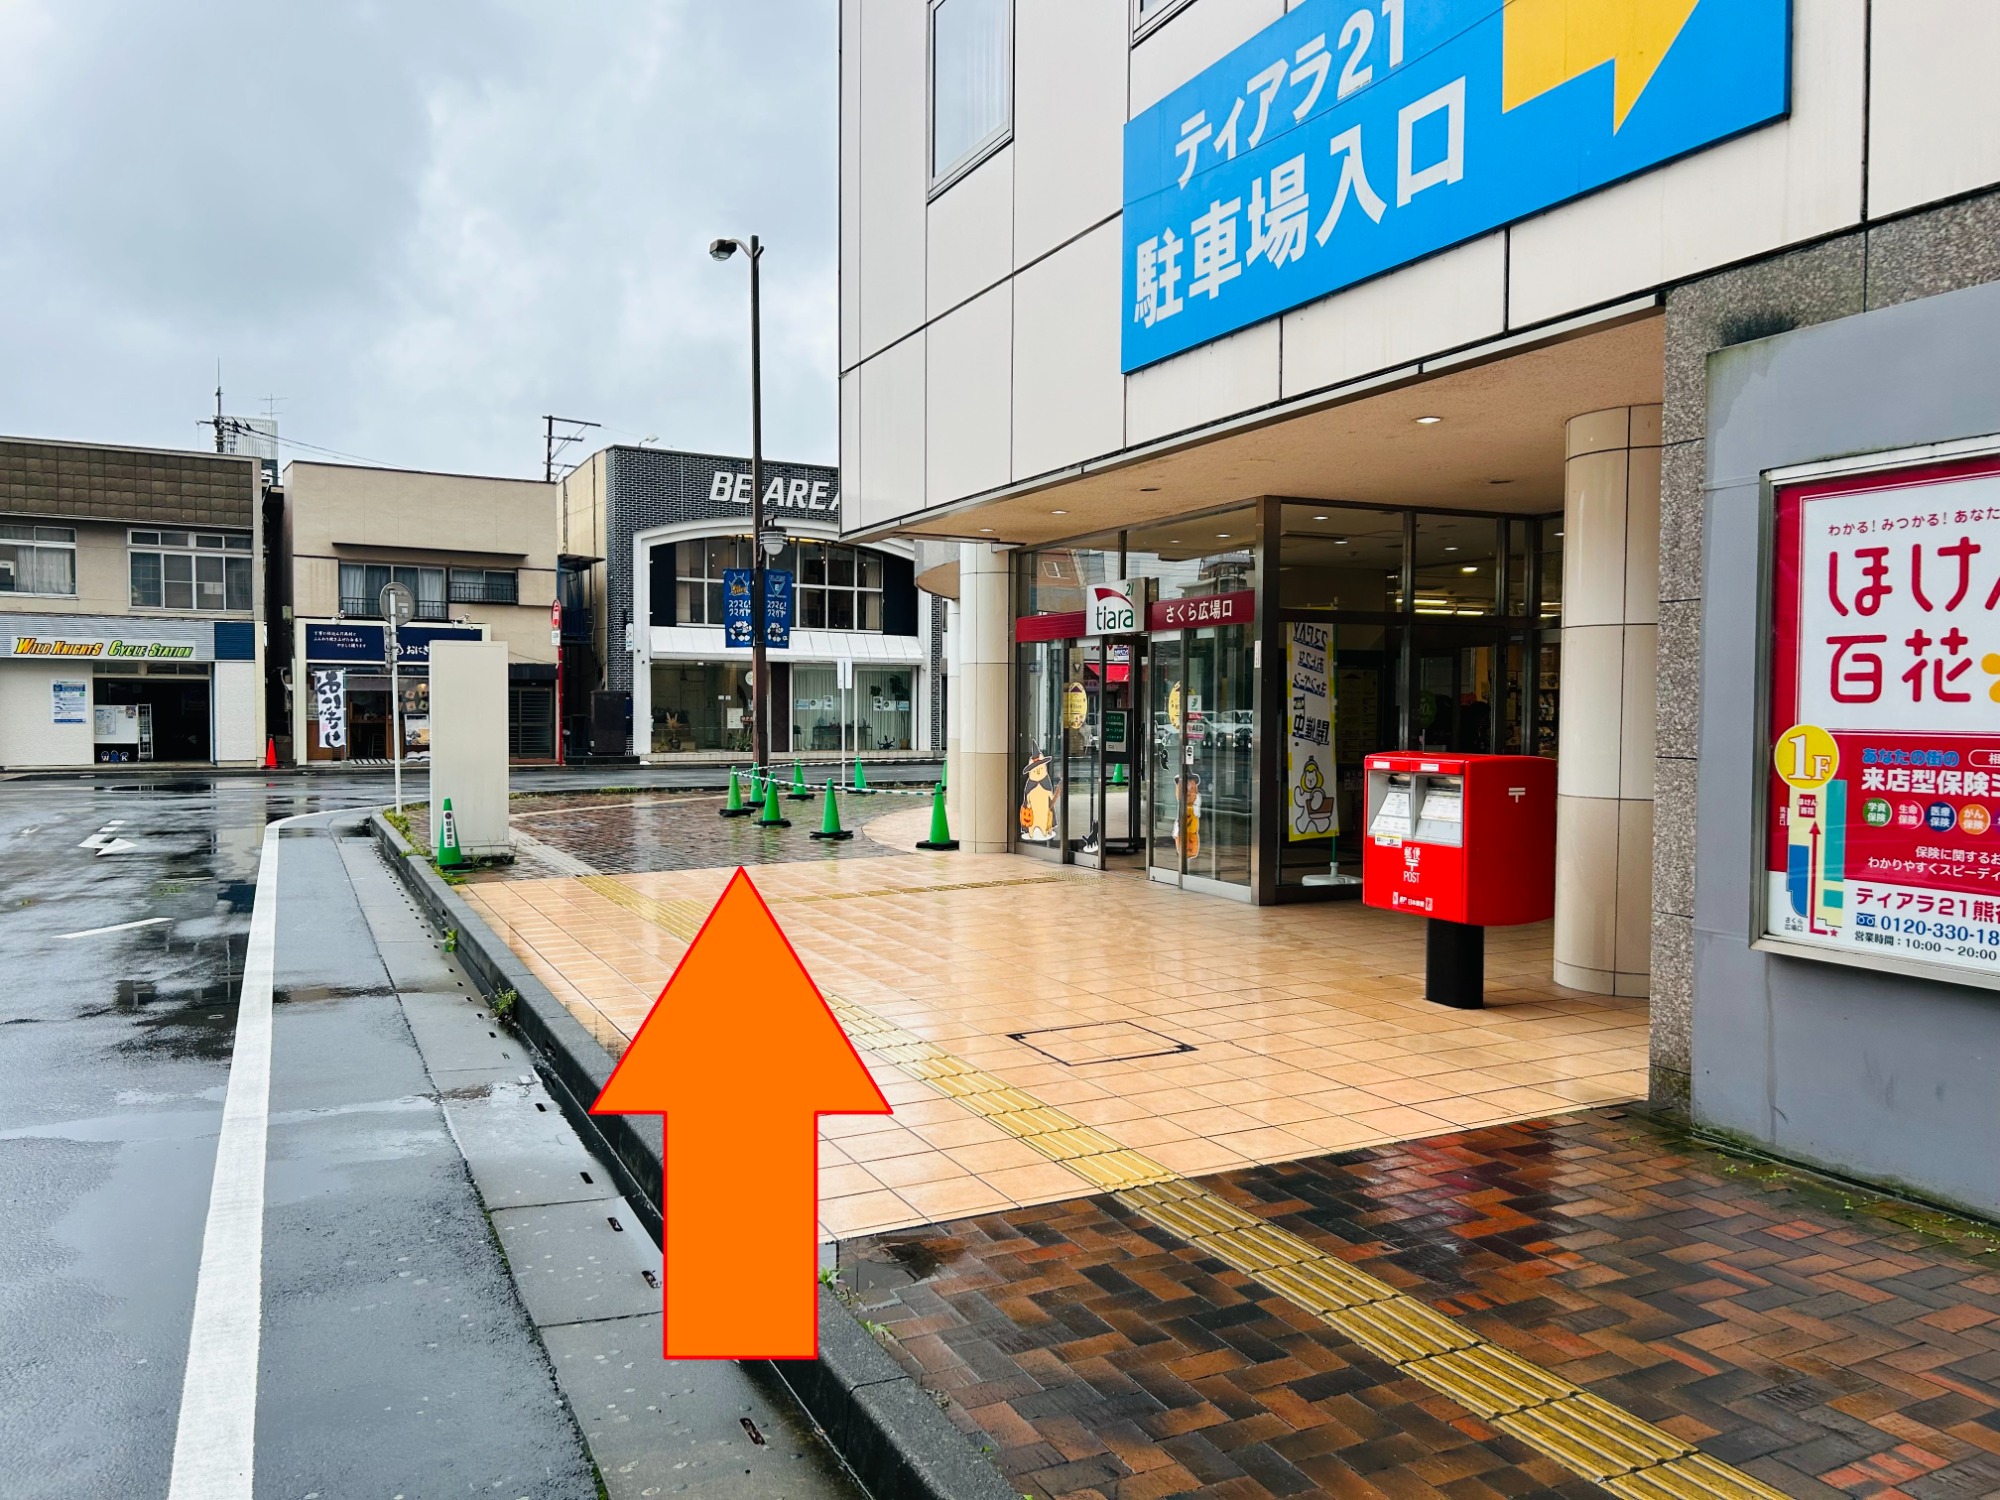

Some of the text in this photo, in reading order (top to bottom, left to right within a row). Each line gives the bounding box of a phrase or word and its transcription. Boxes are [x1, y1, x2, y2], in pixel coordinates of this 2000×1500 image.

[1174, 0, 1404, 190] ティアラ21
[1133, 75, 1466, 329] 駐車場入口
[708, 471, 753, 504] BE
[1096, 606, 1134, 631] tiara
[1166, 599, 1233, 623] さくら広場口
[14, 636, 194, 658] WILD KNIGHTS CYCLE STATION
[1826, 627, 1973, 704] 百花
[1788, 733, 1831, 780] 1F
[1862, 748, 1960, 767] あなたの街の
[1867, 812, 1886, 823] 保険
[1898, 804, 1918, 815] 生命
[1930, 806, 1951, 817] 医療
[1964, 808, 1984, 819] がん
[1898, 815, 1918, 825] 保険
[1930, 817, 1950, 828] 保険
[1963, 819, 1984, 831] 保険
[1403, 870, 1421, 883] POST
[1880, 915, 2000, 947] 0120-330-18
